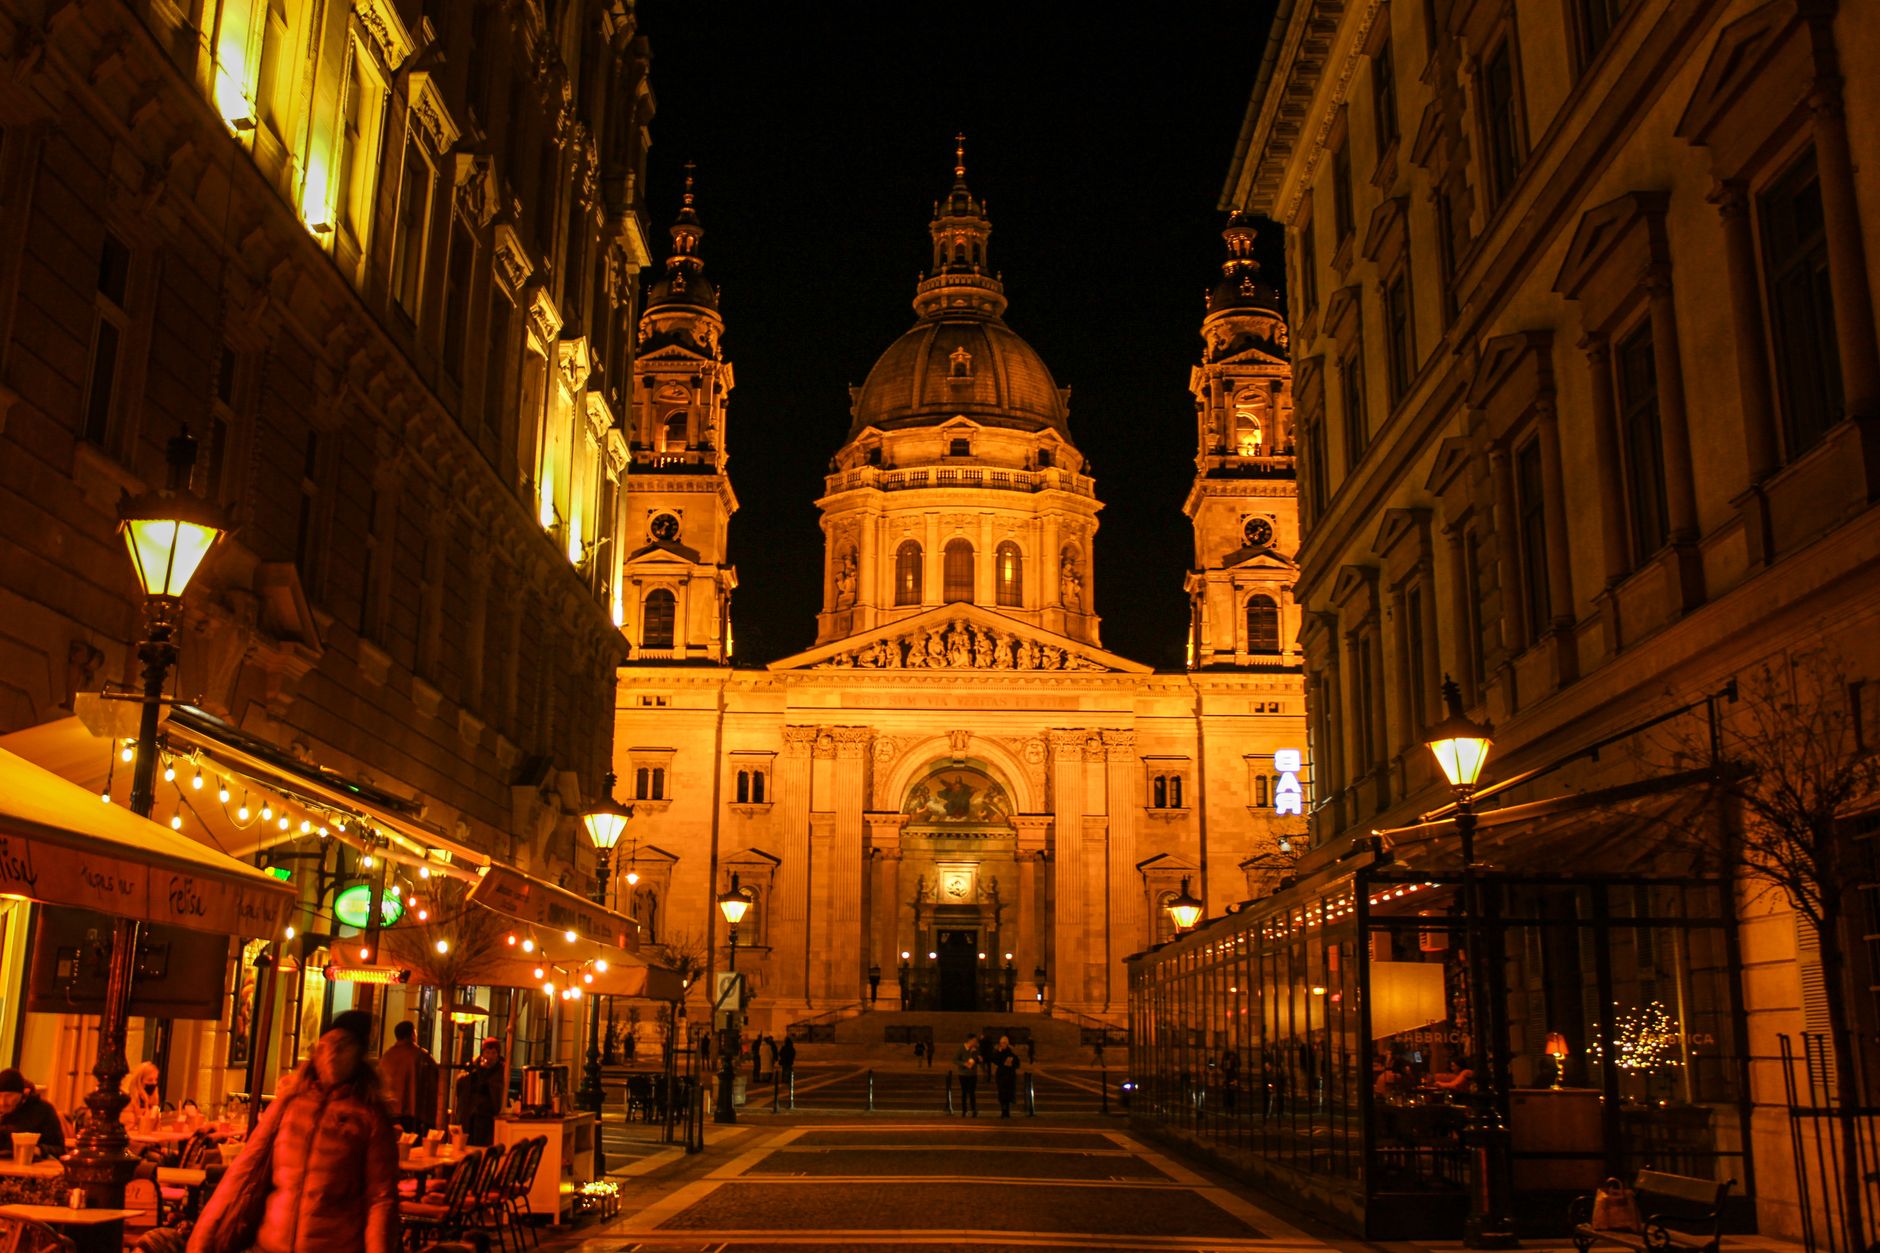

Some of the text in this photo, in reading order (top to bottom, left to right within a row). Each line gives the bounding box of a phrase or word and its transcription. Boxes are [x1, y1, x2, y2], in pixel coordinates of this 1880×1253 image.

[889, 694, 916, 706] SUM
[927, 695, 948, 706] VIA
[1016, 697, 1029, 707] ET
[1274, 749, 1302, 815] BAR
